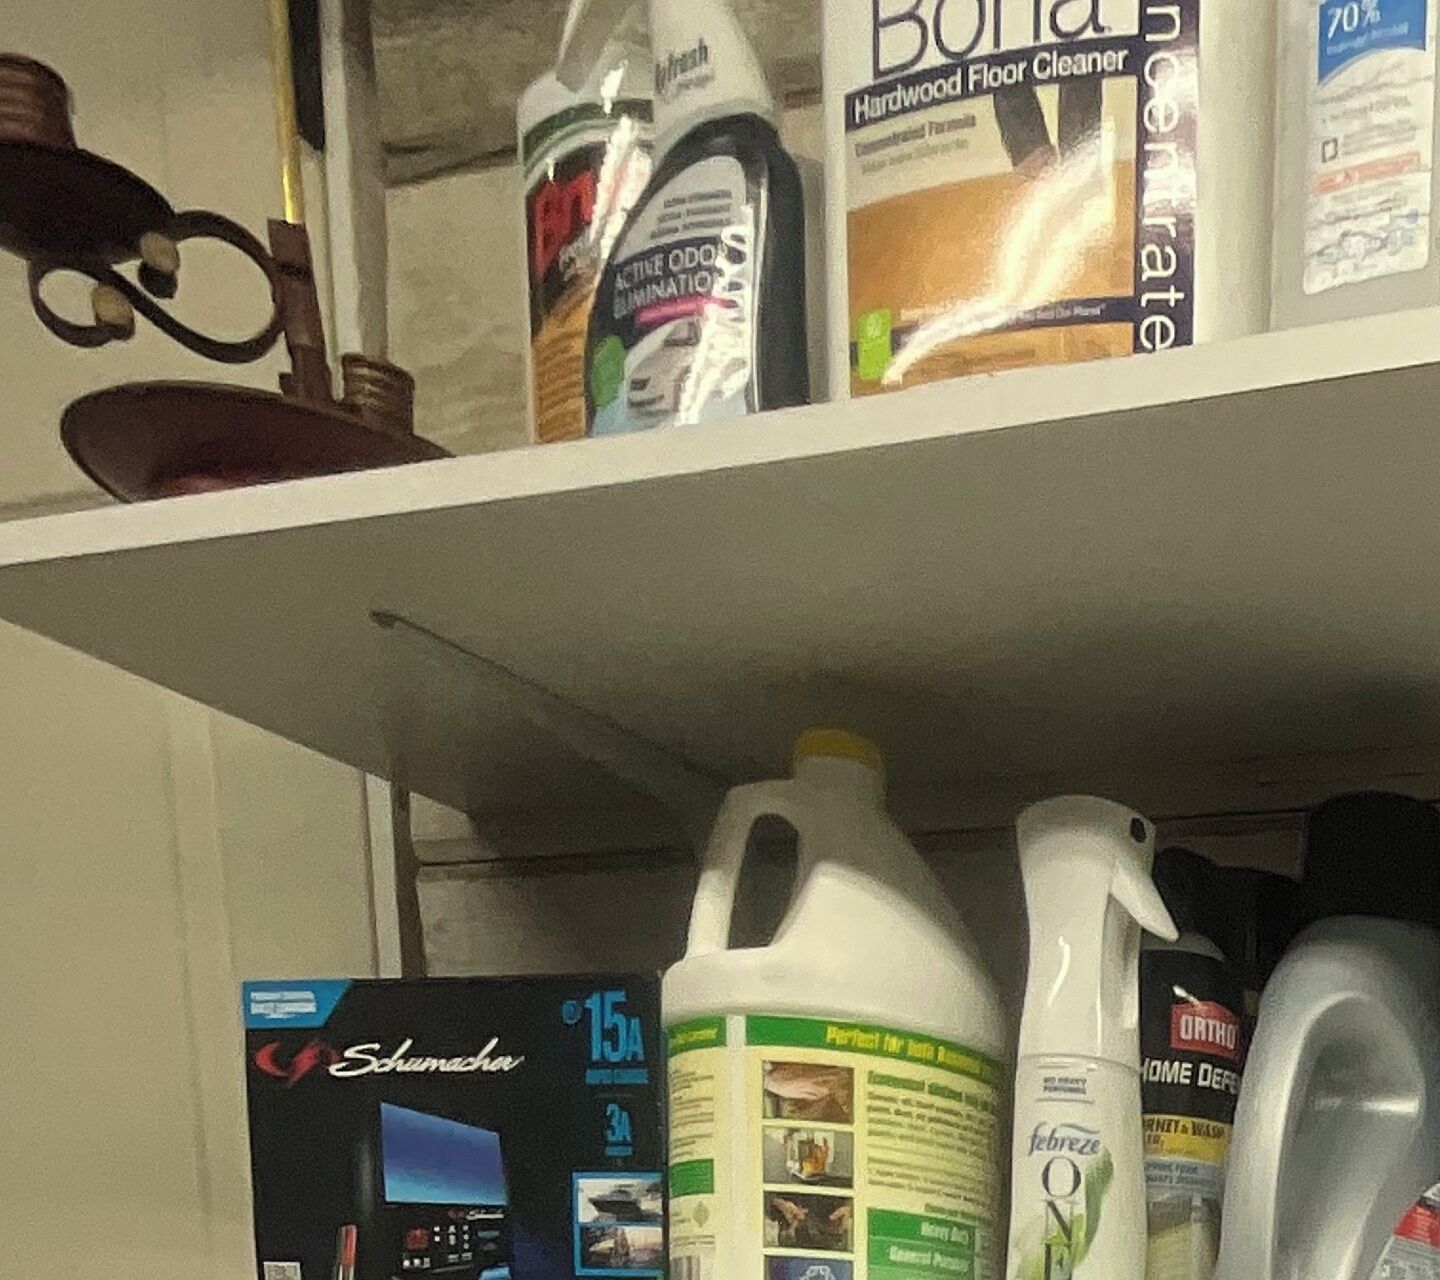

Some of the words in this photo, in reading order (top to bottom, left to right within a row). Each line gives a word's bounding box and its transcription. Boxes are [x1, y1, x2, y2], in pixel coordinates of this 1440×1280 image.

[853, 78, 963, 125] Hardwood
[967, 60, 1028, 91] Floor
[1032, 49, 1130, 80] Cleaner
[1139, 0, 1184, 350] ncentrate
[614, 252, 664, 291] ACTIVE
[584, 989, 646, 1063] 15A
[1180, 1015, 1237, 1051] ORTHO
[329, 1036, 525, 1079] Schumacher
[1140, 1057, 1194, 1085] HOME
[1197, 1062, 1241, 1096] DEFE
[1028, 1122, 1100, 1156] febreze
